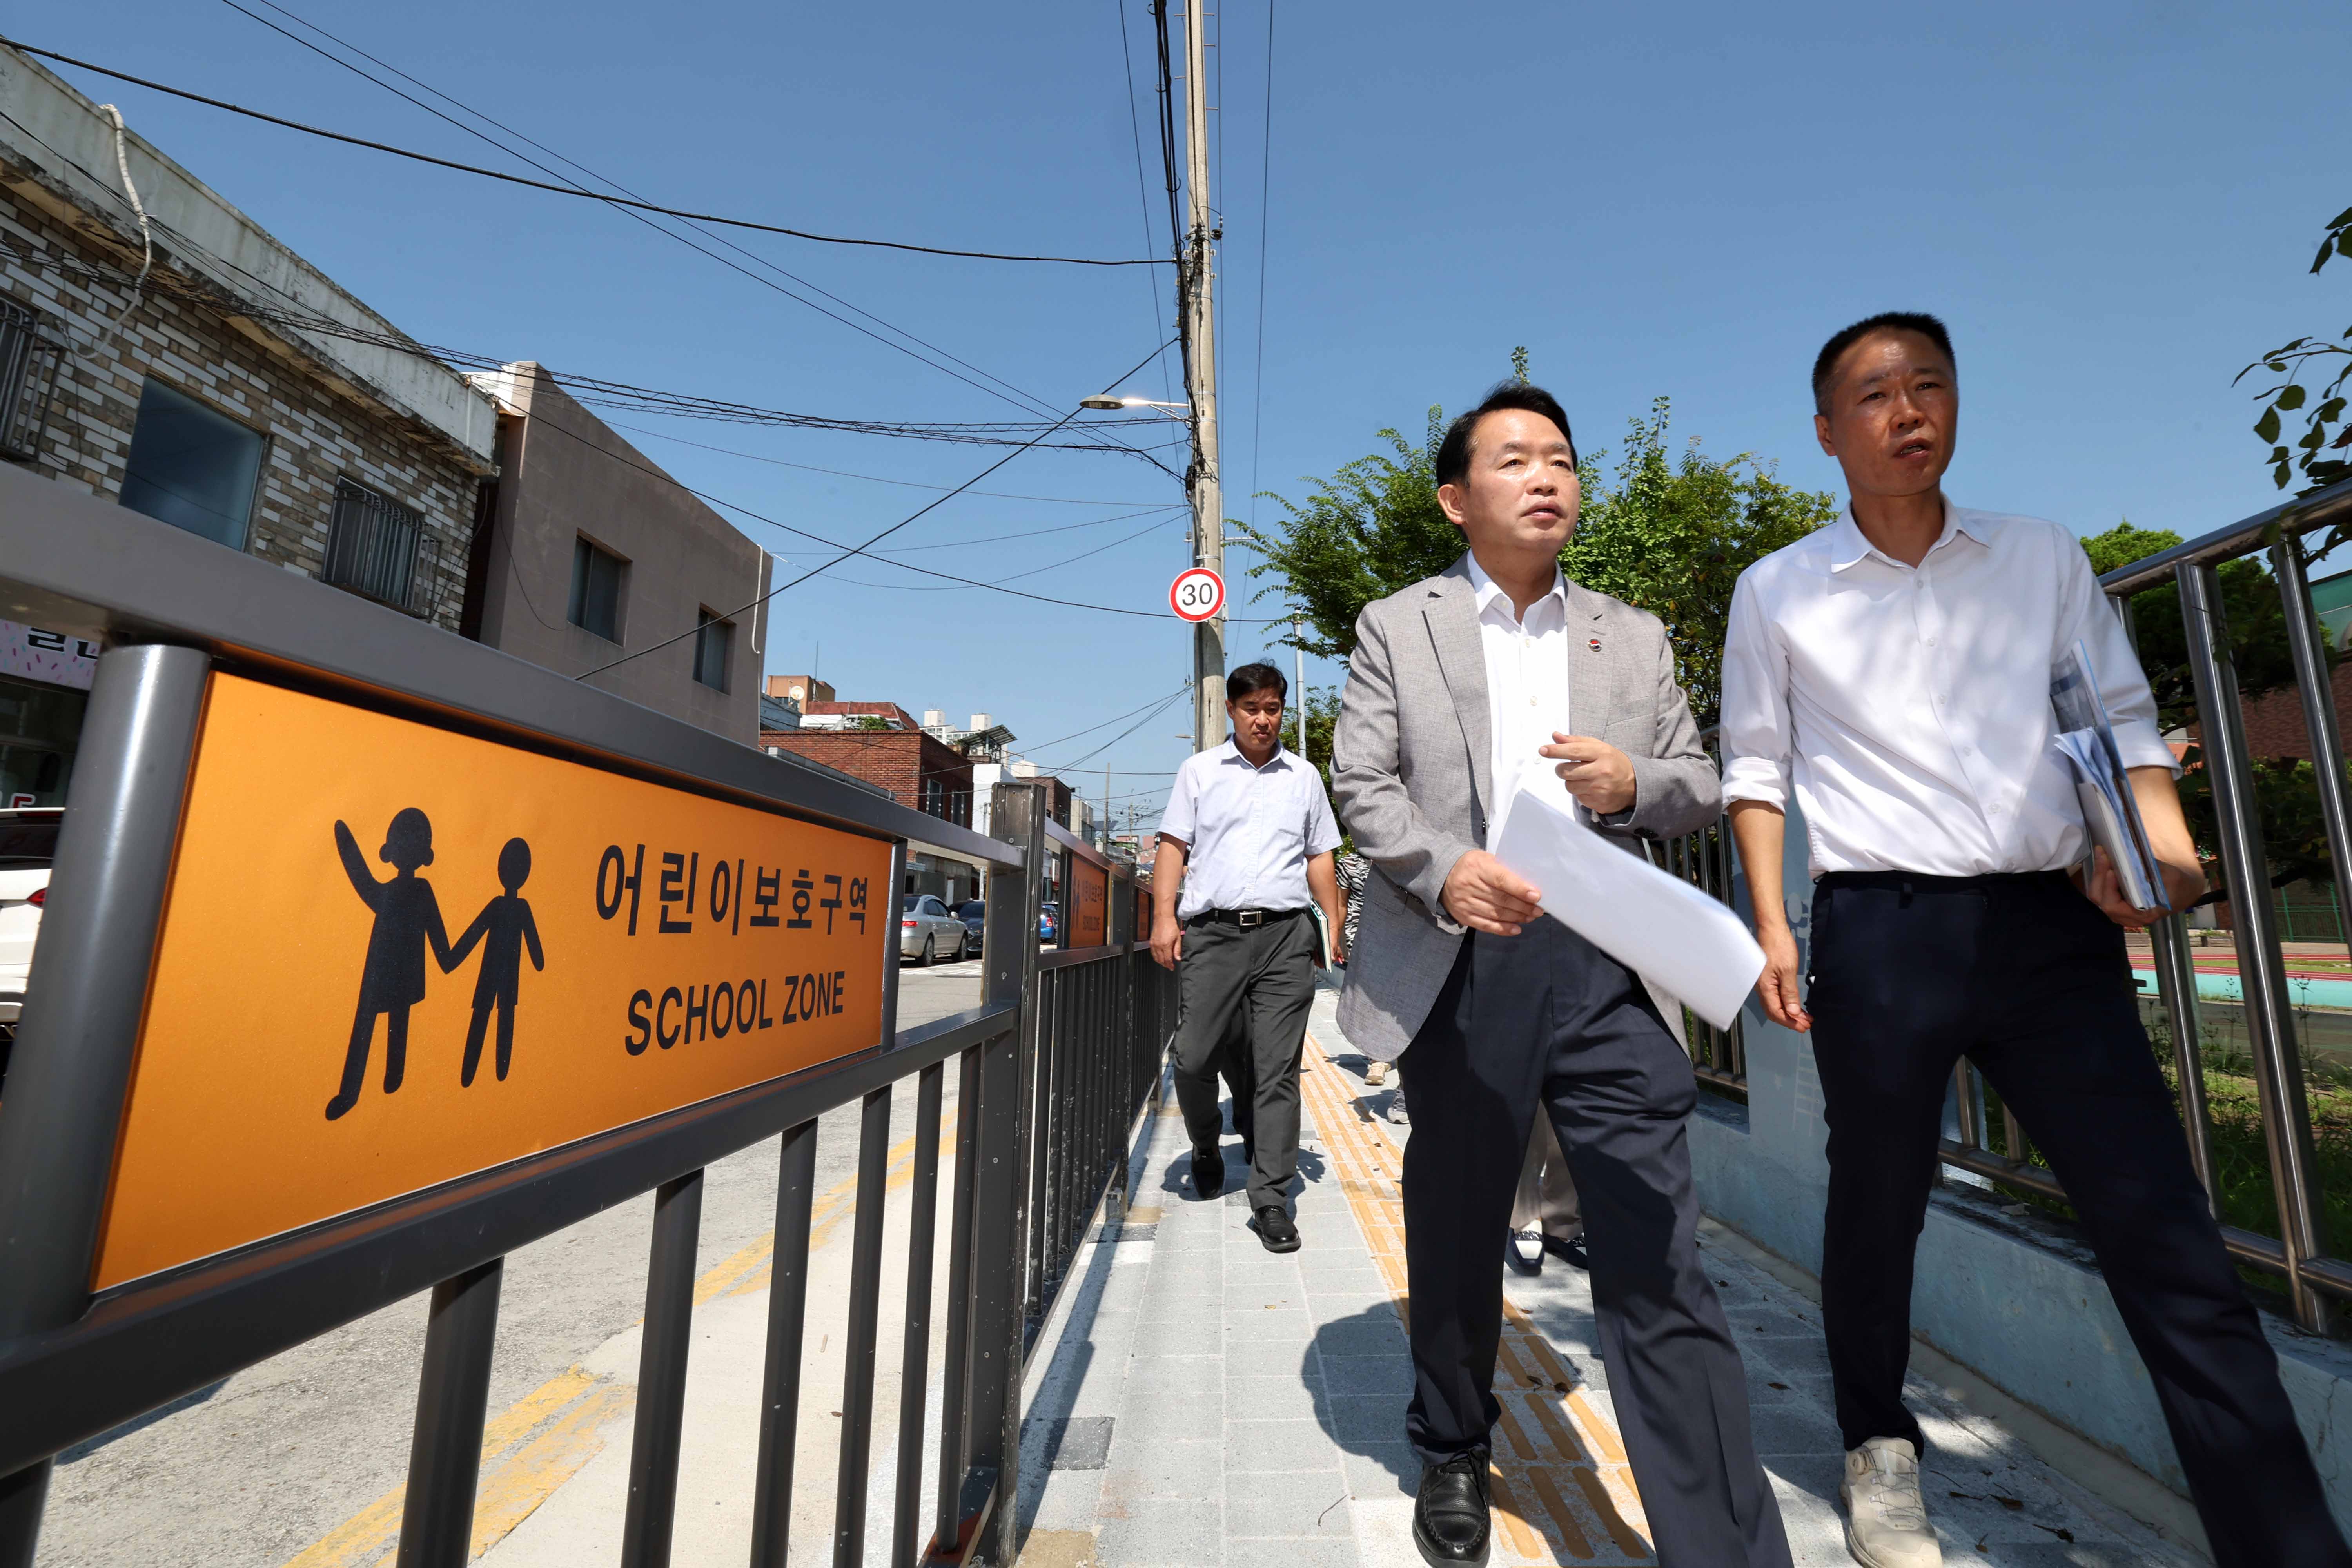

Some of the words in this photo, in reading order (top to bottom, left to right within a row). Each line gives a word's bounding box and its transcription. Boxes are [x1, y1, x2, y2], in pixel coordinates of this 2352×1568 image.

[1182, 583, 1213, 606] 30
[595, 843, 868, 936] 어린이보호구역
[624, 978, 773, 1056] SCHOOL
[782, 970, 845, 1025] ZONE
